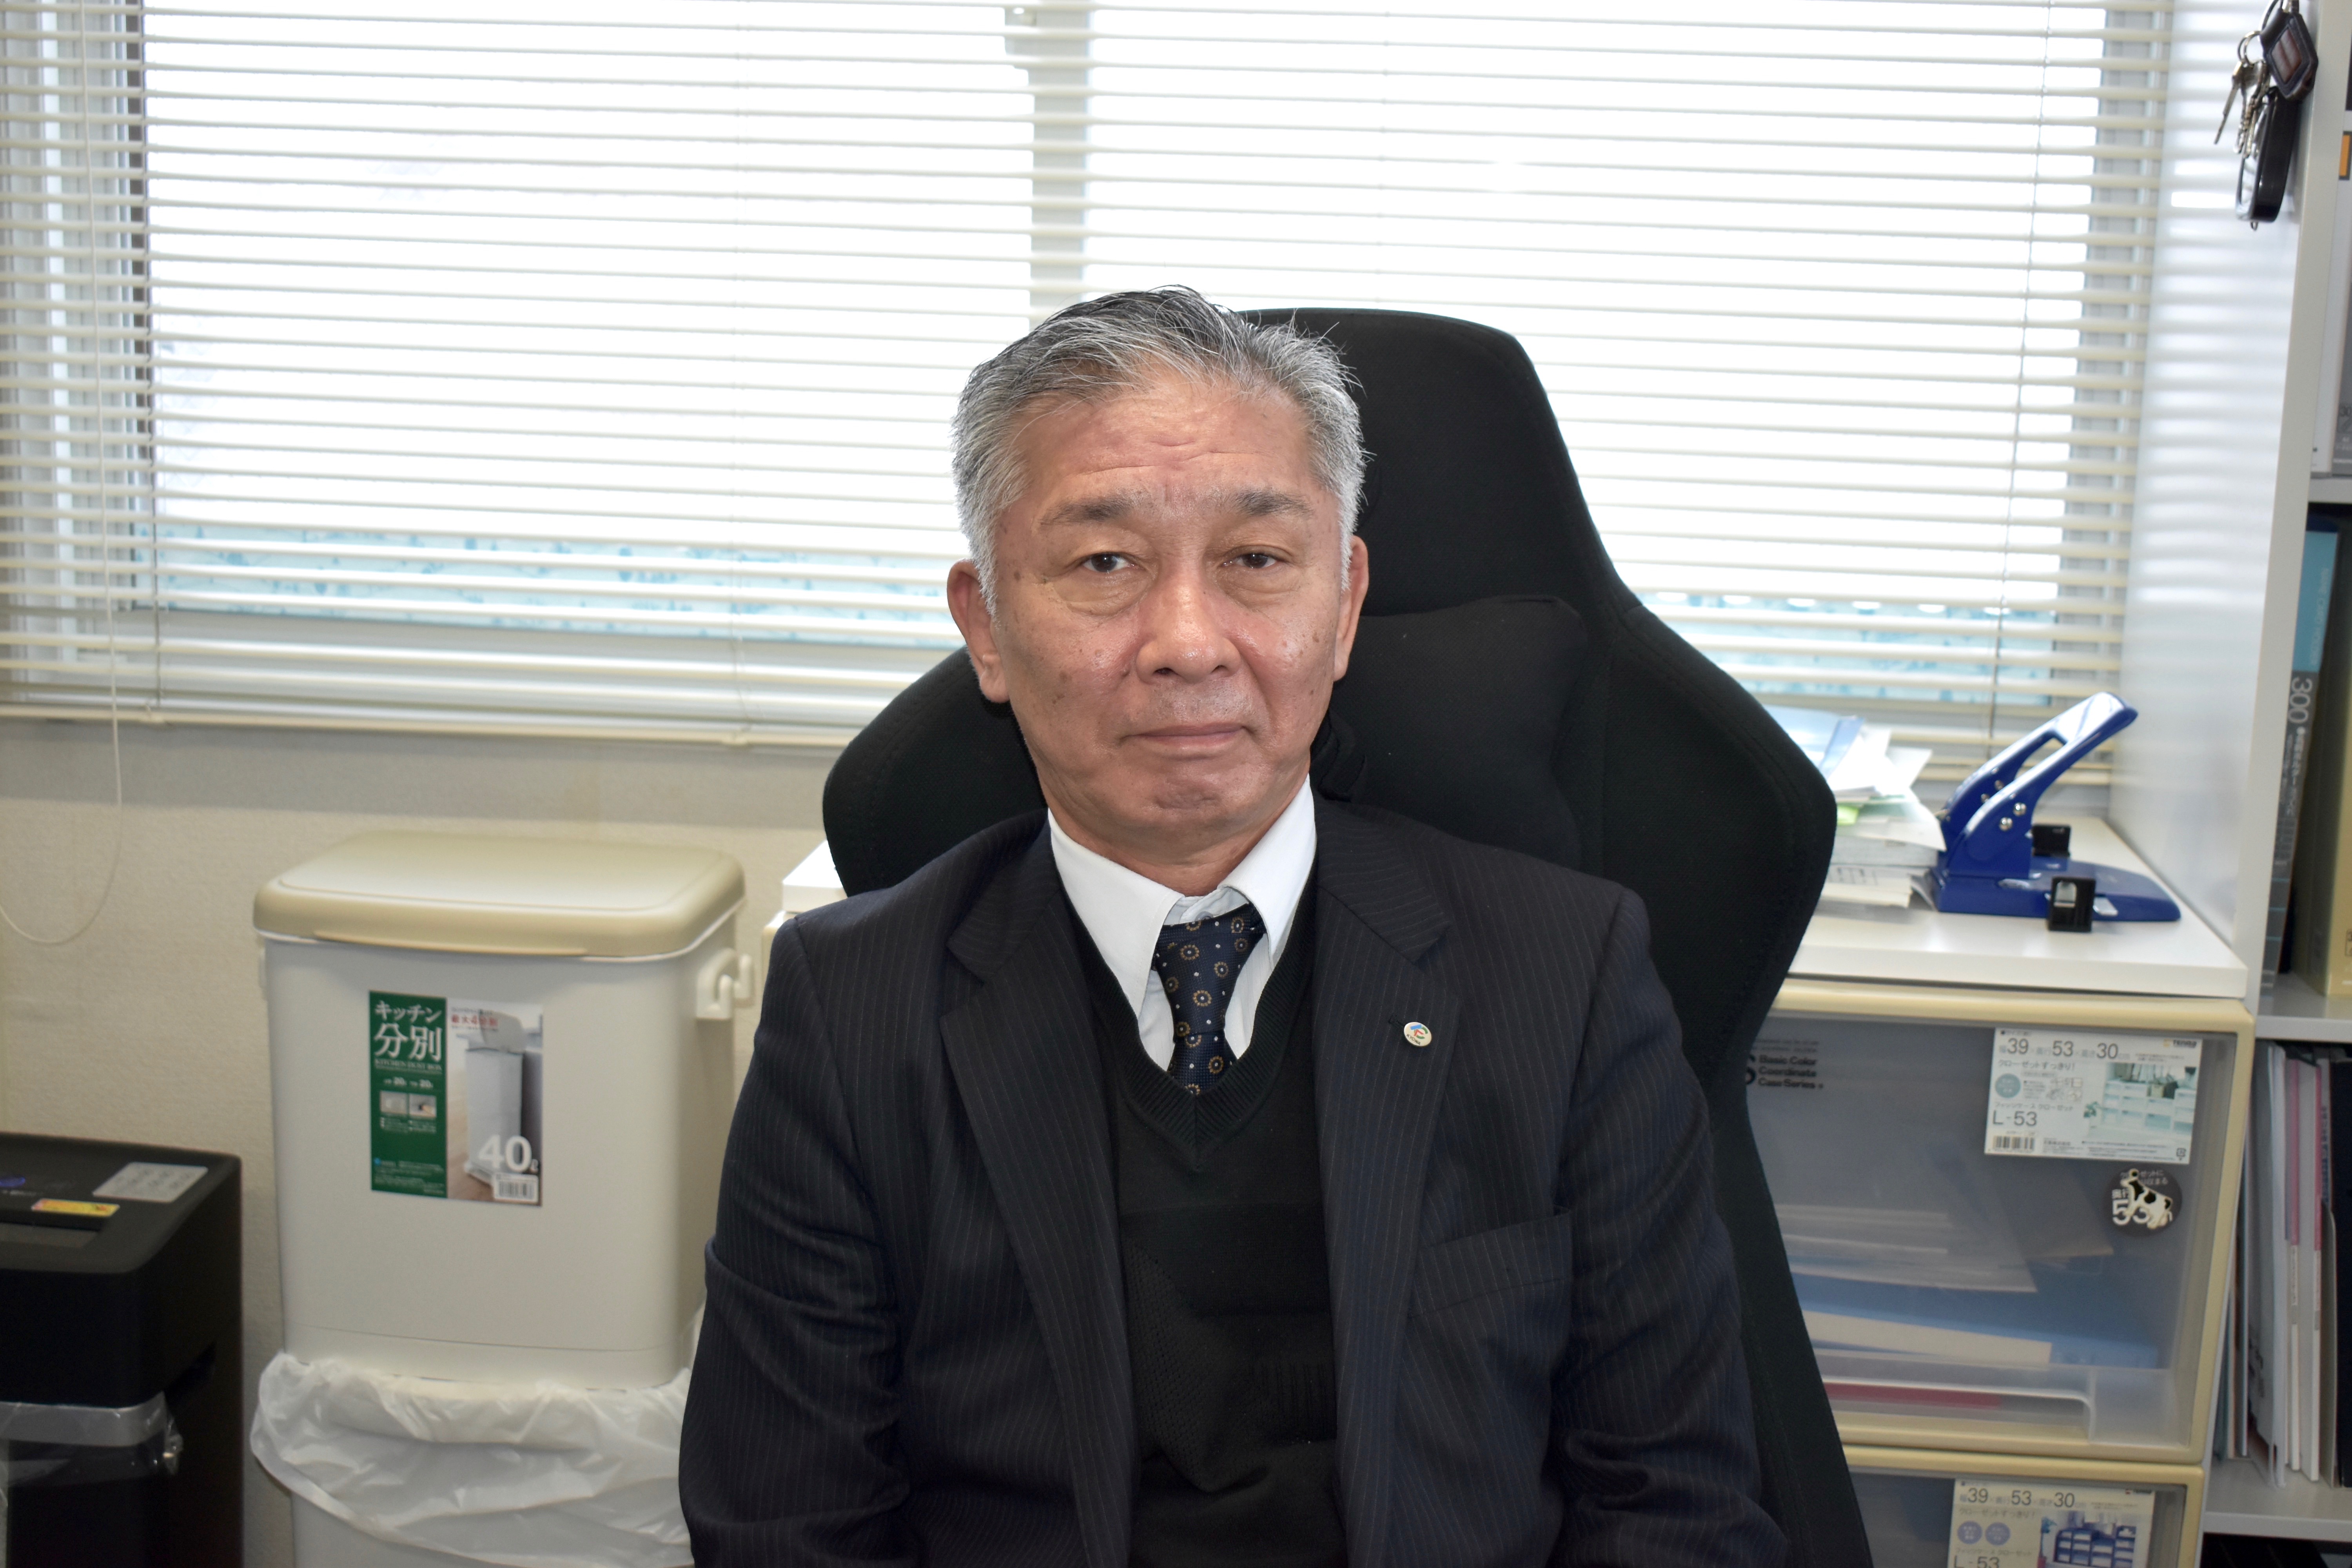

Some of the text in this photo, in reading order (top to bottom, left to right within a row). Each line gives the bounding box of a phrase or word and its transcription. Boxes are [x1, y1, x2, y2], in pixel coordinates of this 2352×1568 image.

[2287, 677, 2312, 724] 300
[375, 1000, 442, 1024] キッチン
[374, 1023, 443, 1062] 分別
[1406, 1034, 1421, 1045] KYOWA
